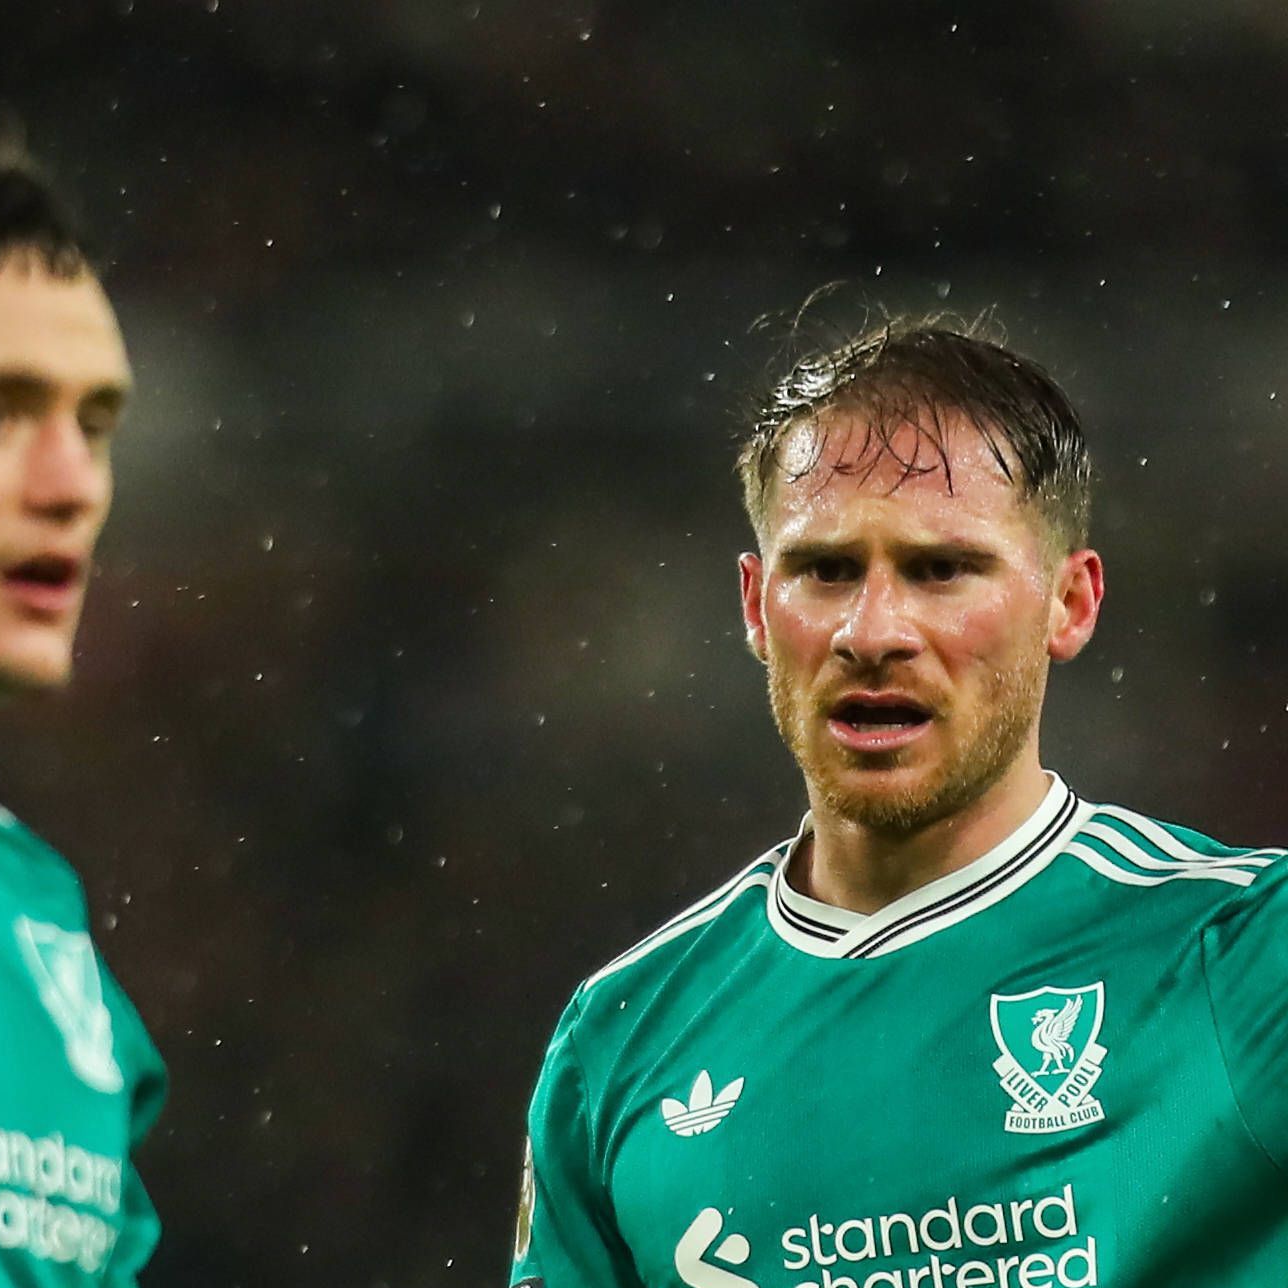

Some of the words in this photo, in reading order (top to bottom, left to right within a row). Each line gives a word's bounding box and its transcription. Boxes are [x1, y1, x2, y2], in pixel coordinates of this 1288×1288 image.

[1007, 1072, 1048, 1113] LIVER
[1058, 1066, 1096, 1108] POOL
[1009, 1115, 1066, 1129] FOOTBALL
[1070, 1106, 1099, 1123] CLUB
[781, 1183, 1078, 1270] standard
